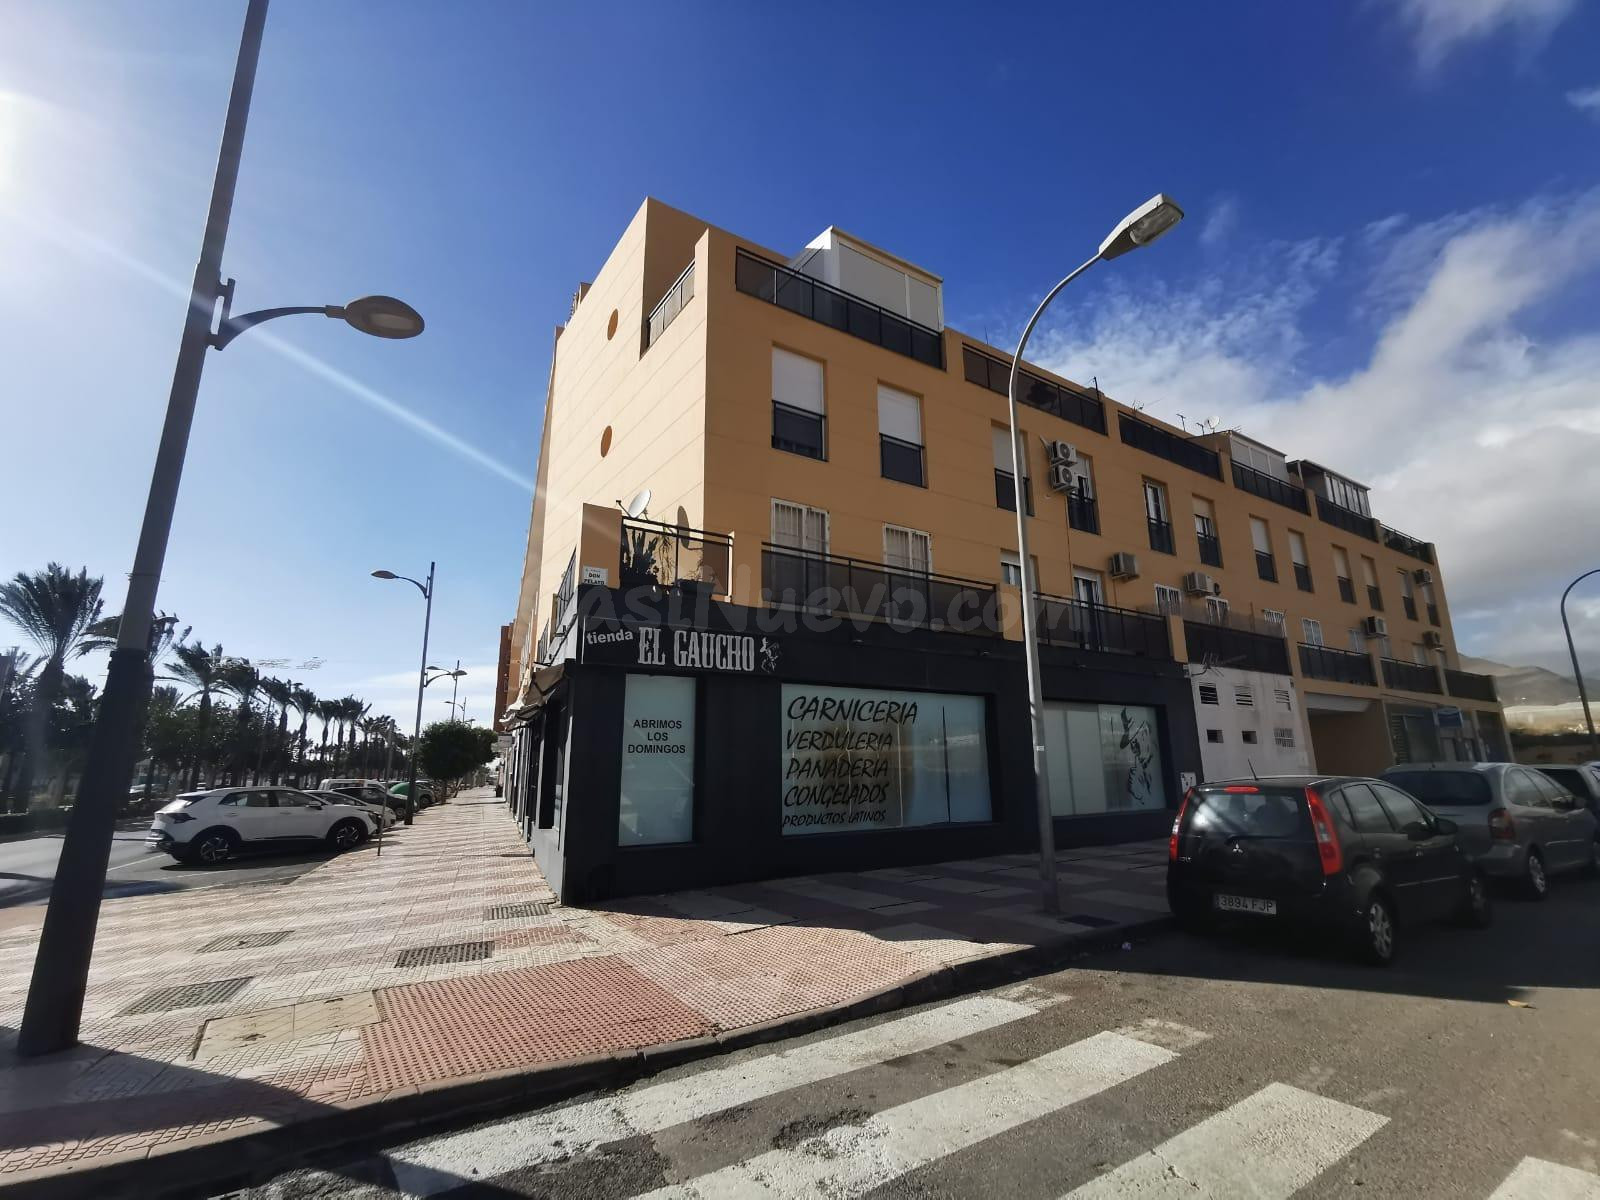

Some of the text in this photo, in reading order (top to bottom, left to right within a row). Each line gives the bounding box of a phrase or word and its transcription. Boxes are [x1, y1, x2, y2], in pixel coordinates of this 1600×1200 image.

[586, 626, 755, 671] tienda EL GAUCHO
[787, 696, 918, 725] CARNICERIA
[633, 719, 682, 729] ABRIMOS
[647, 731, 669, 741] LOS
[786, 729, 893, 752] VERDULERIA
[627, 744, 686, 754] DOMINGOS
[785, 757, 889, 780] PANADERIA
[783, 783, 890, 808] CONGELADOS
[782, 809, 887, 828] PRODUCTOS LATINOS
